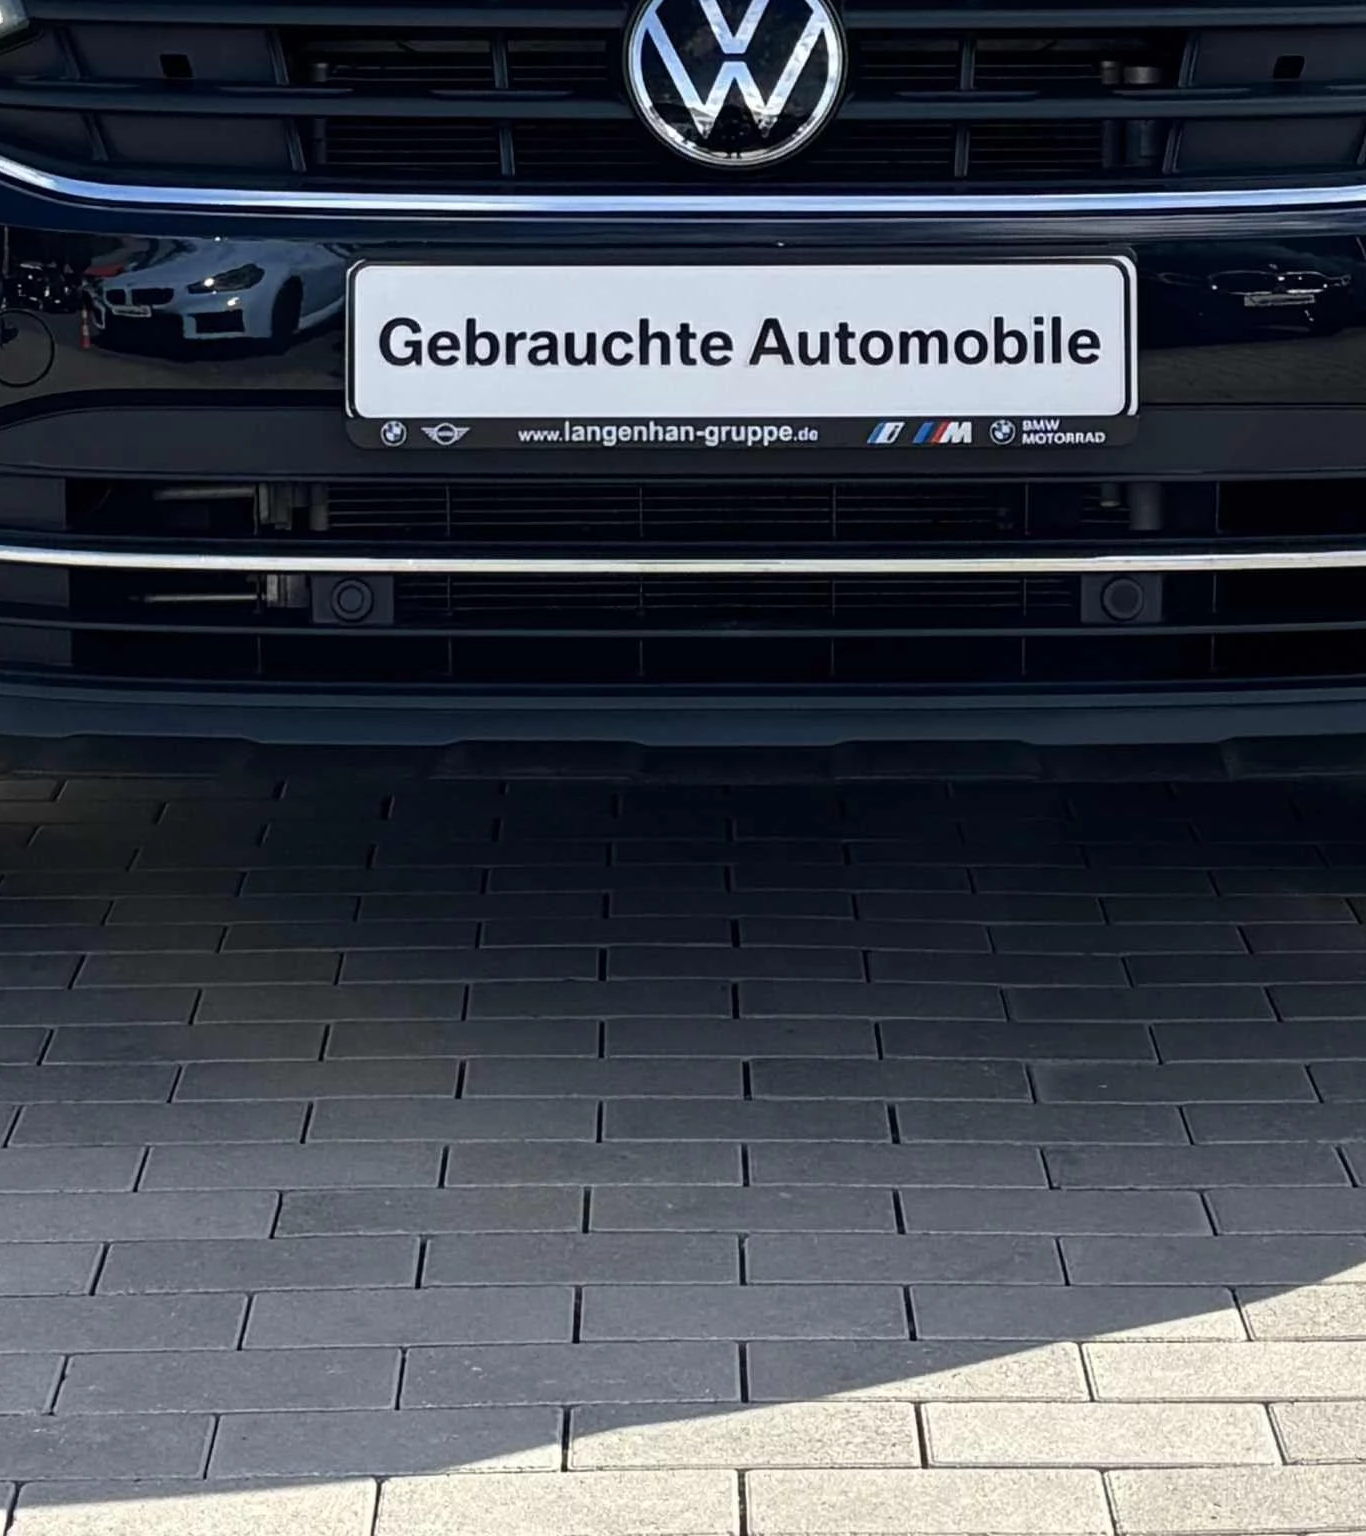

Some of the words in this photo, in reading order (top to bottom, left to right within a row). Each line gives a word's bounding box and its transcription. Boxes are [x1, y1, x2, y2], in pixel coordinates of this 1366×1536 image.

[378, 316, 735, 367] Gebrauchte
[748, 315, 1103, 366] Automobile
[517, 420, 819, 446] www.langenhan-gruppe.de
[1022, 419, 1061, 432] BMW
[1022, 431, 1106, 445] MOTORRAD
